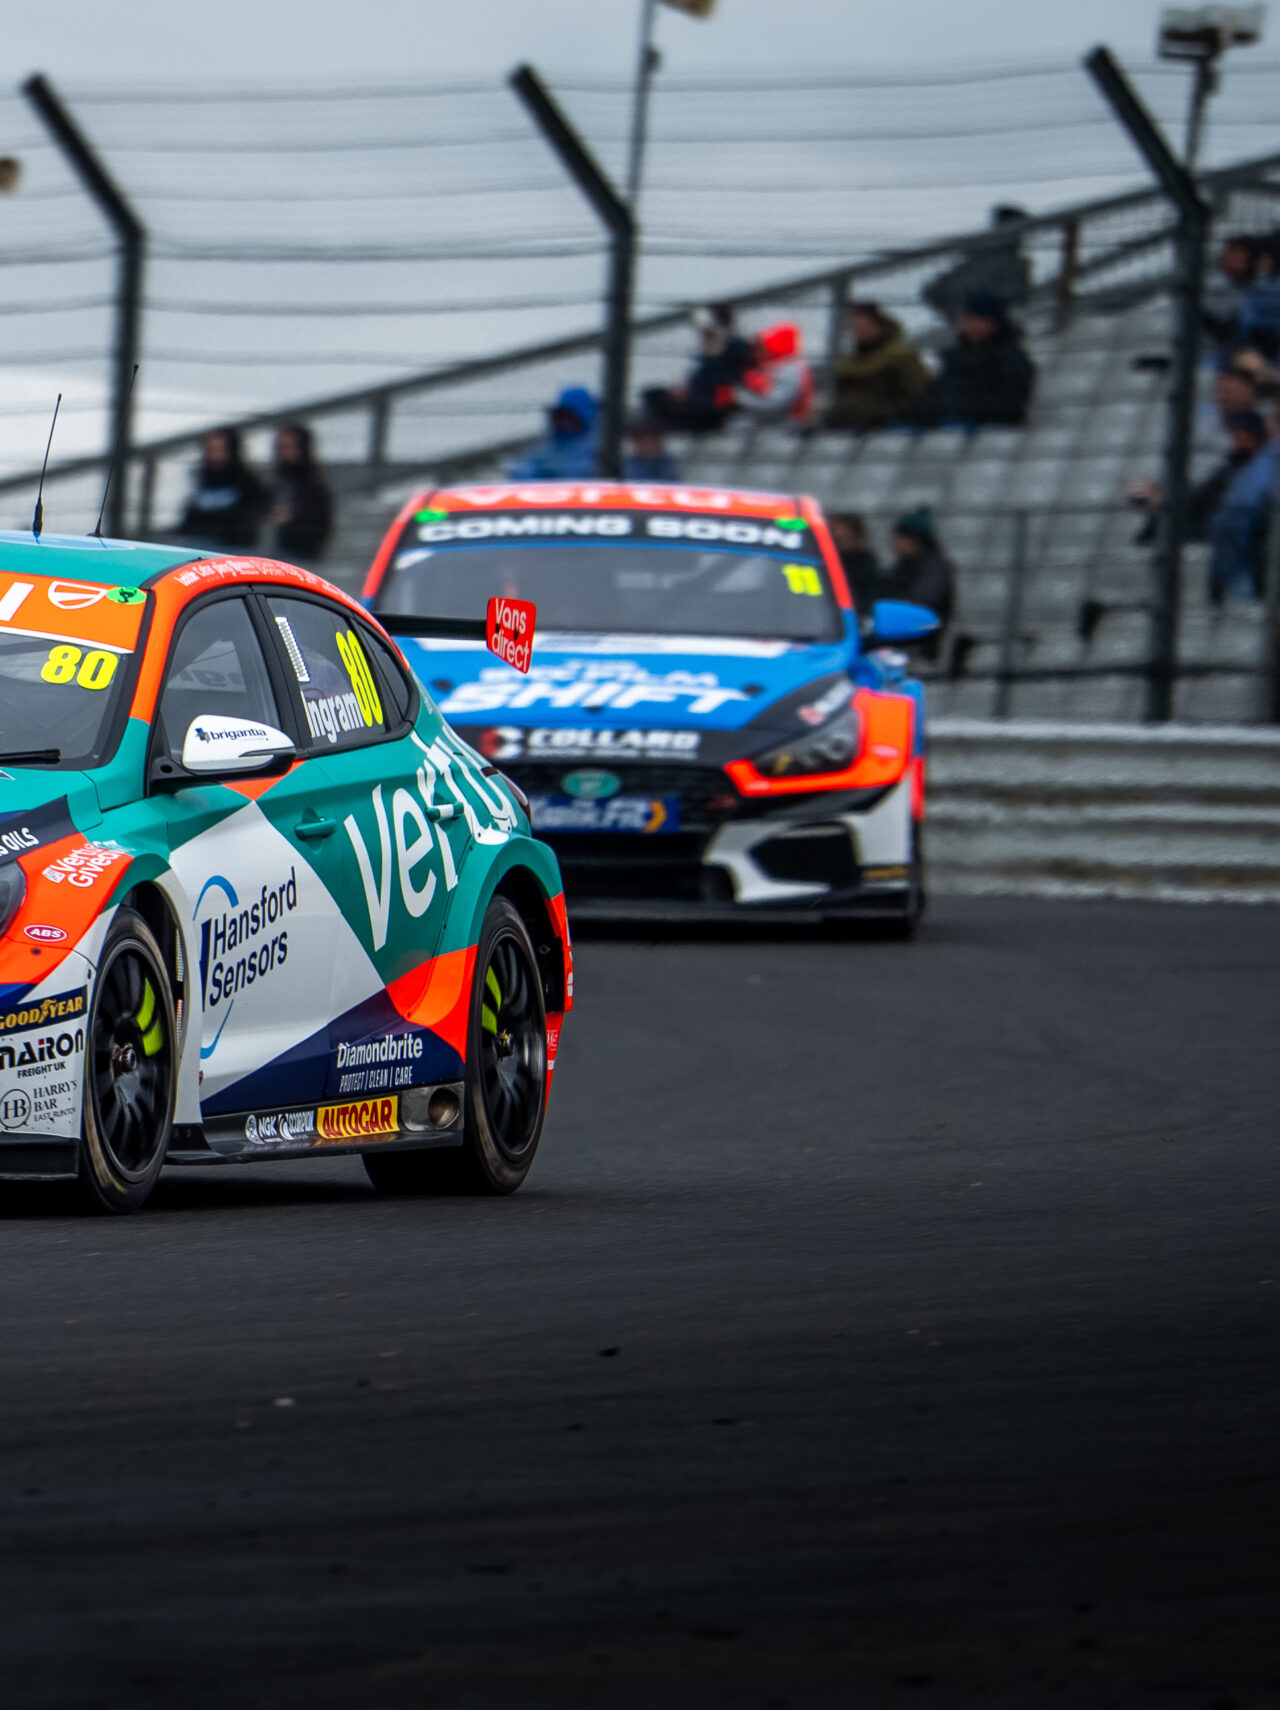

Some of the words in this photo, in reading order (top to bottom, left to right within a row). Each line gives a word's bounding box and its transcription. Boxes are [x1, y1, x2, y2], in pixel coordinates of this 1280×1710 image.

[419, 515, 632, 542] COMING
[646, 517, 803, 549] SOON
[782, 564, 822, 597] 11
[495, 598, 527, 634] Vans
[40, 644, 119, 690] 80
[492, 629, 530, 673] direct
[336, 629, 384, 728] 80
[437, 681, 750, 714] SHIFT
[210, 728, 267, 741] brigantia
[527, 730, 701, 749] COLLARD
[1, 827, 40, 852] OILS
[213, 866, 298, 960] Hansford
[30, 927, 62, 939] ABS
[208, 930, 288, 1008] Sensors
[336, 1032, 424, 1069] Diamondbrite
[17, 1063, 53, 1079] FREIGHT
[53, 1061, 66, 1071] UK
[339, 1070, 365, 1093] PROTECT
[368, 1068, 388, 1089] CLEAN
[394, 1065, 413, 1085] CARE
[33, 1098, 58, 1112] BAR
[322, 1099, 393, 1138] AUTOCAR
[258, 1115, 277, 1138] NGK
